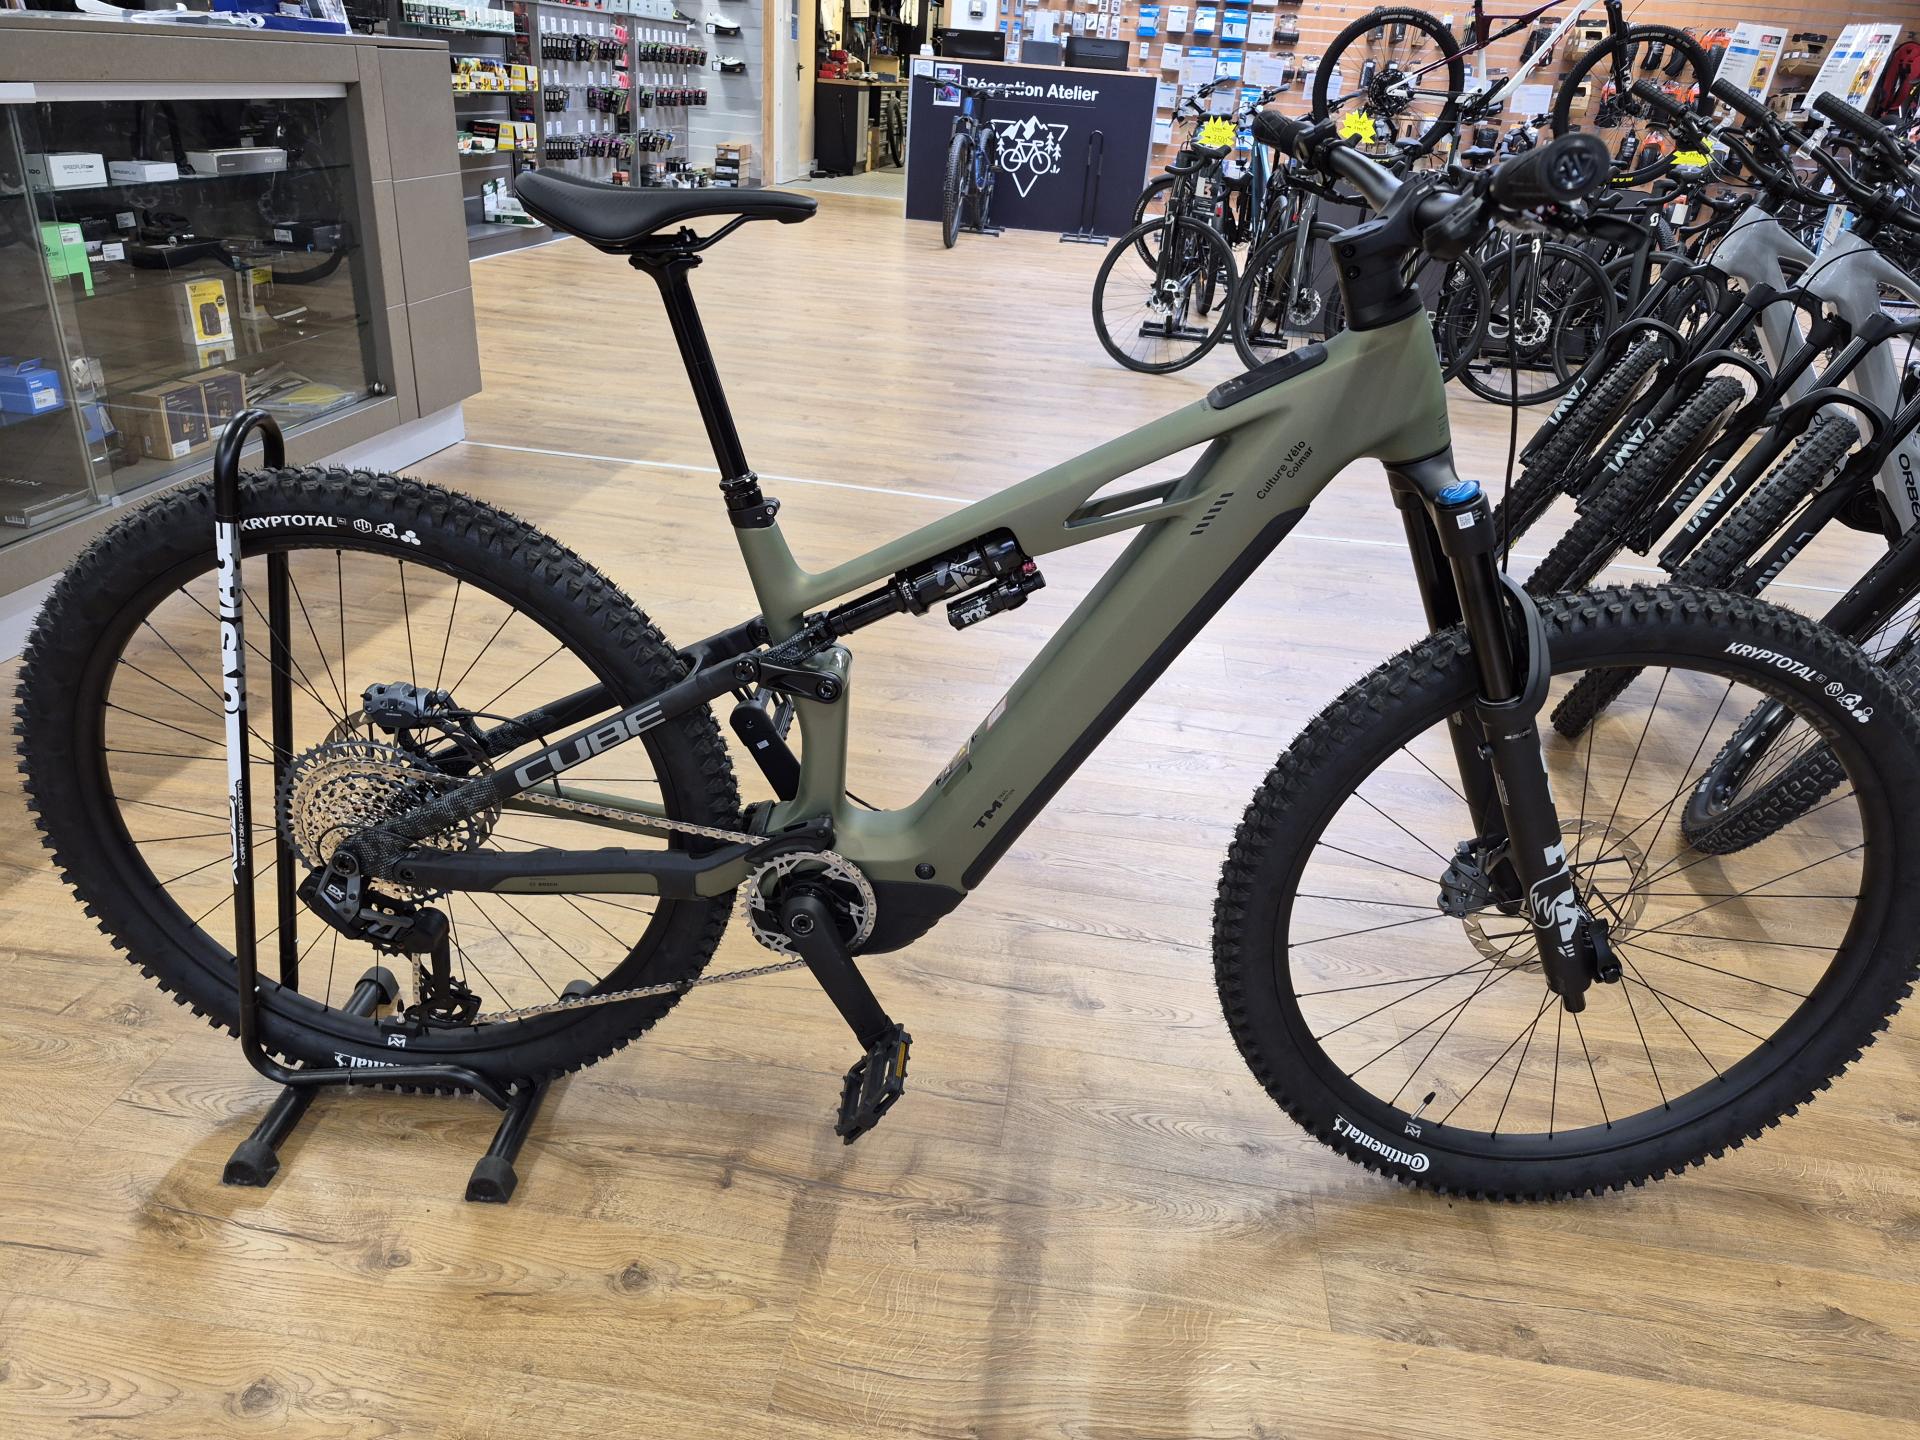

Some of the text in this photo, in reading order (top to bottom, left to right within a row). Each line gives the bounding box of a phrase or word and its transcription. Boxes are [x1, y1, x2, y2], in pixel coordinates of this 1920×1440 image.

[1046, 83, 1099, 102] Atelier
[1256, 440, 1306, 500] Culture Vélo
[1286, 445, 1314, 480] Colmar
[1898, 453, 1920, 520] ORBE
[239, 515, 338, 531] KRYPTOTAL
[960, 603, 991, 625] FOX
[1723, 641, 1817, 682] KRYPTOTAL
[514, 700, 666, 788] CUBE
[972, 798, 1003, 830] TM
[327, 883, 346, 899] GX
[1341, 1124, 1430, 1173] Continental
